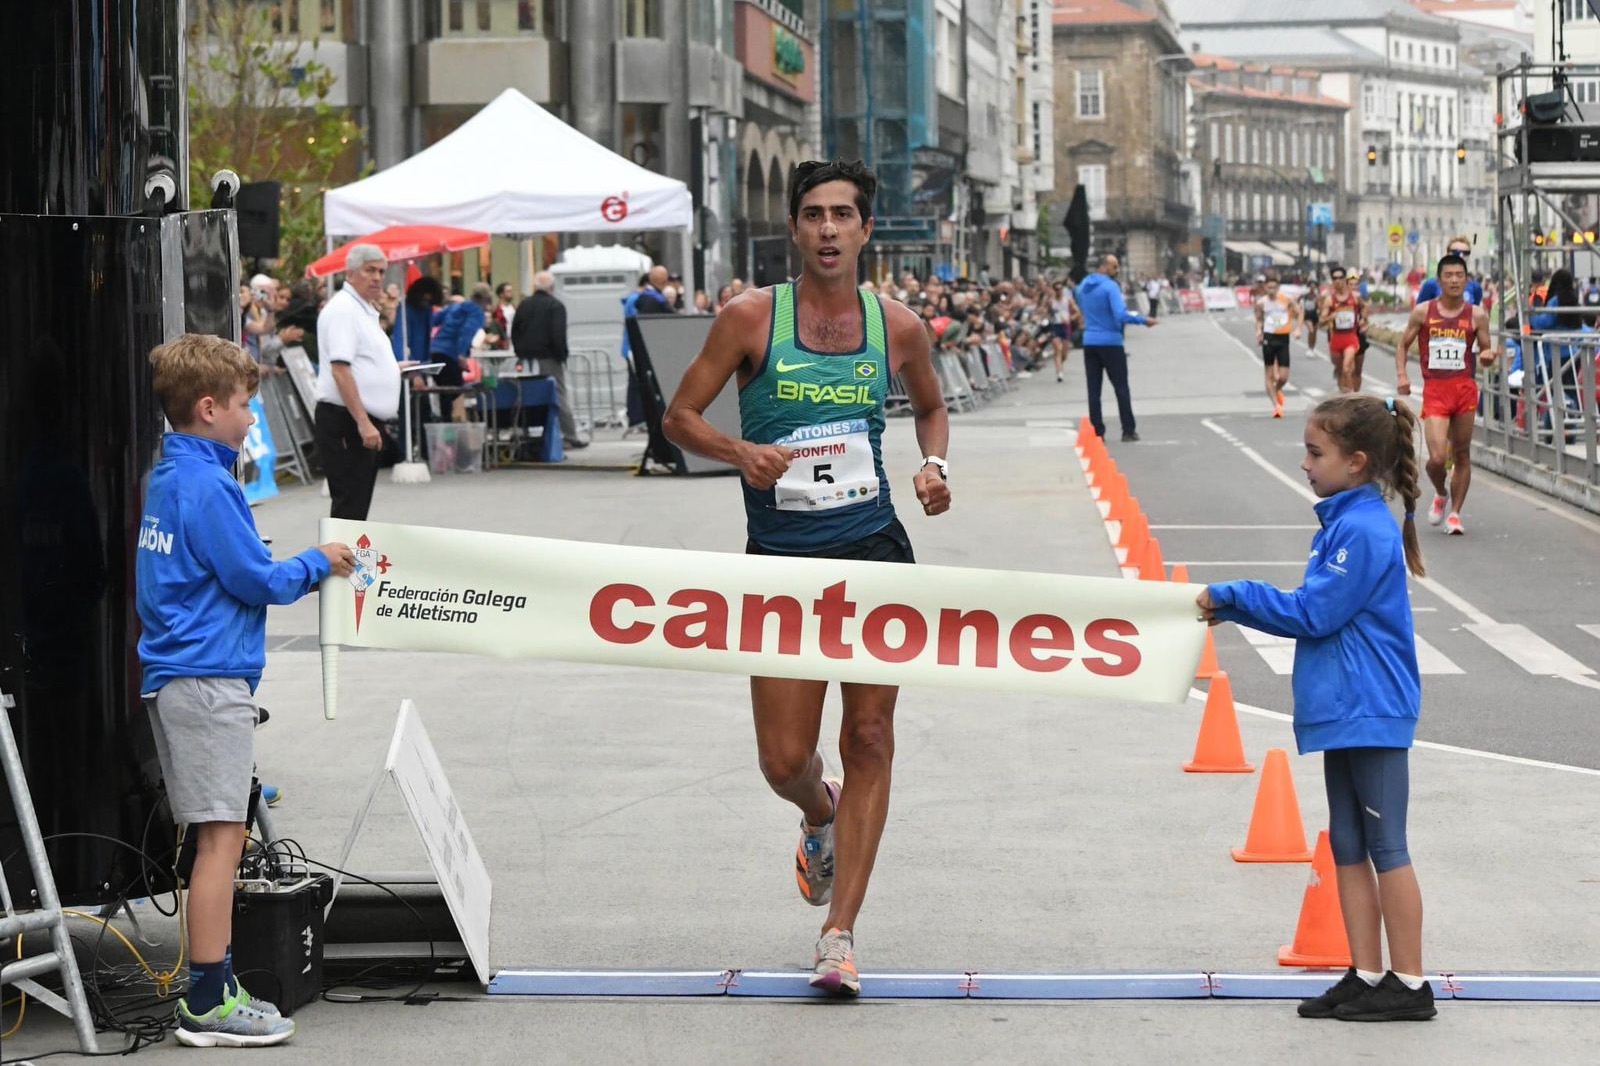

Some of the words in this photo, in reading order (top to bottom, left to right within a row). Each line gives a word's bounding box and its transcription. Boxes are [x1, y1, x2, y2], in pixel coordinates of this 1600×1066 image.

[1428, 327, 1467, 339] CHINA
[1436, 348, 1461, 360] 111
[776, 380, 876, 405] BRASIL
[792, 443, 846, 459] BONFIM
[813, 463, 835, 484] 5
[355, 549, 371, 558] FGA
[377, 581, 459, 603] Federación
[462, 588, 527, 612] Galega
[376, 603, 393, 617] de
[397, 603, 478, 624] Atletismo
[589, 580, 1141, 677] cantones
